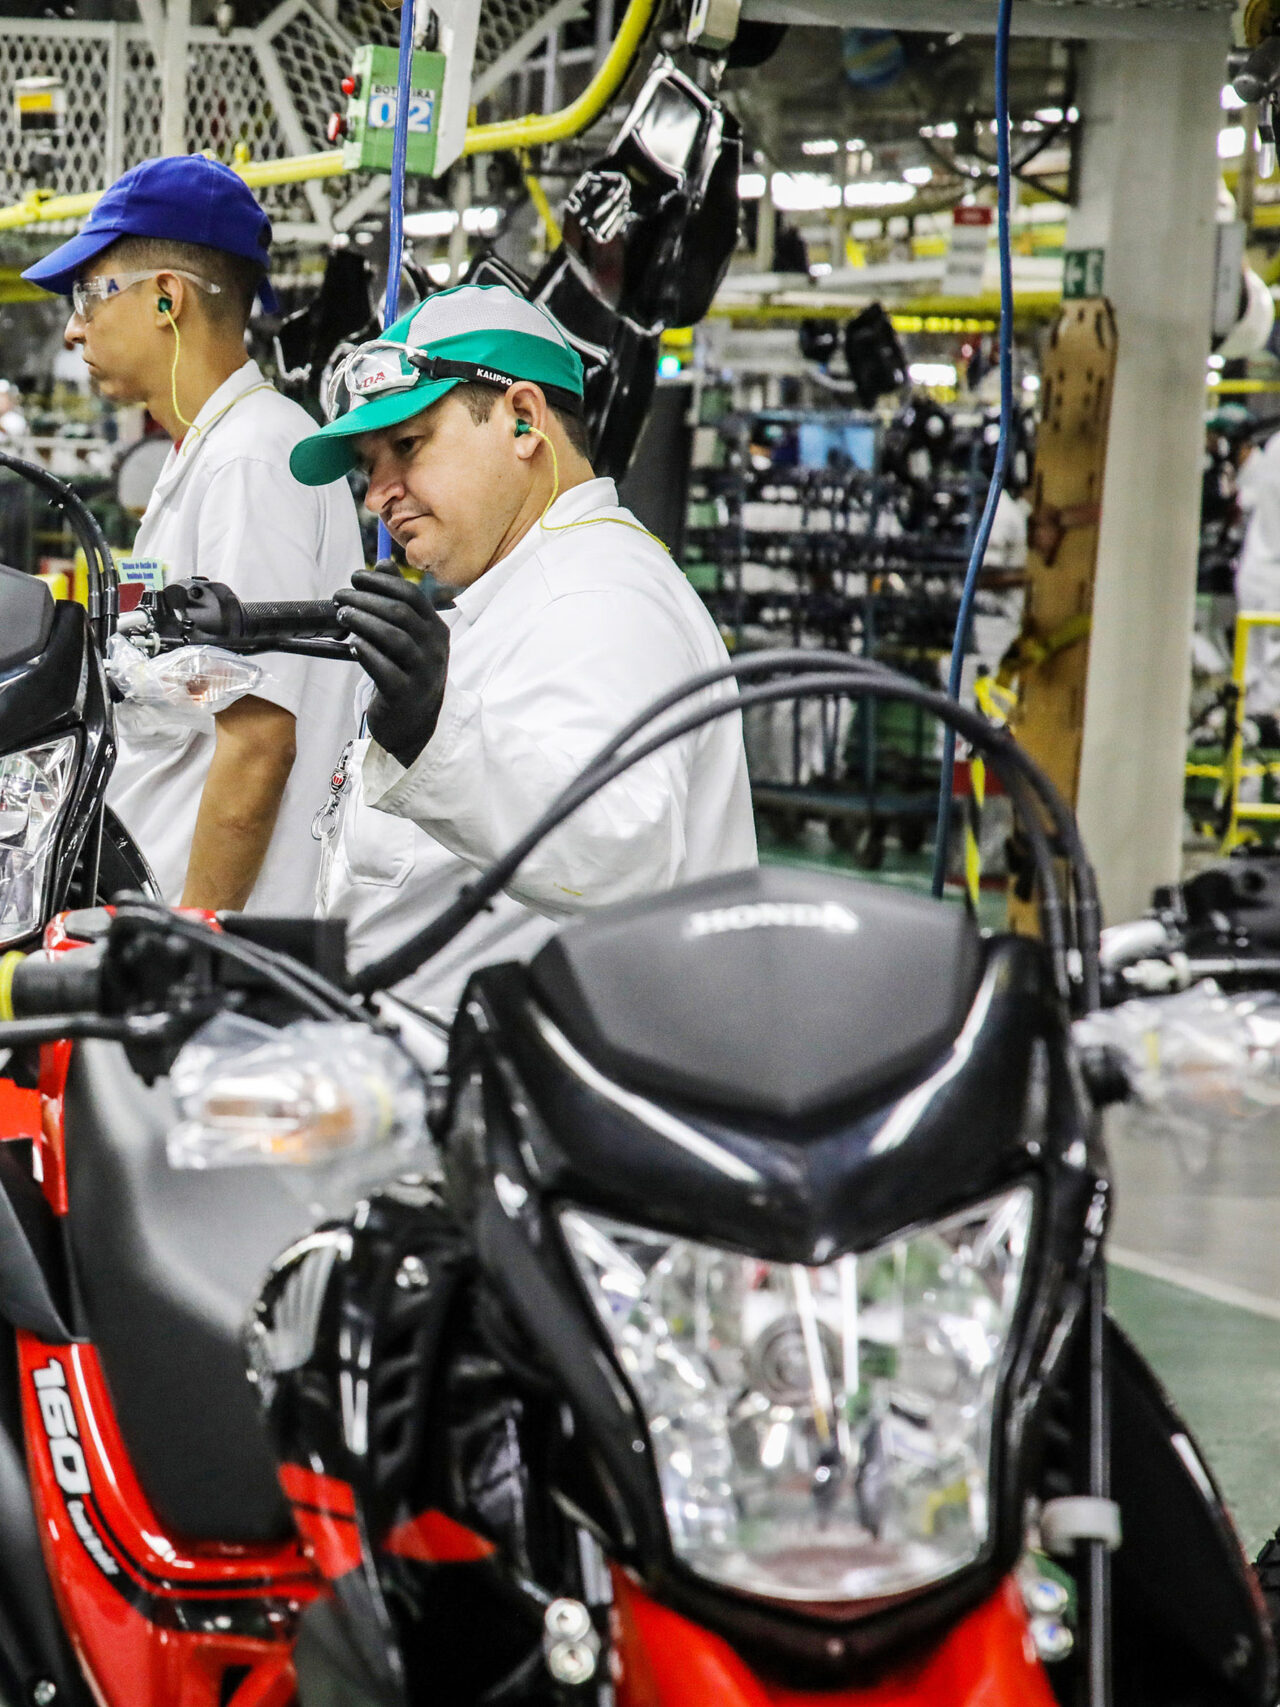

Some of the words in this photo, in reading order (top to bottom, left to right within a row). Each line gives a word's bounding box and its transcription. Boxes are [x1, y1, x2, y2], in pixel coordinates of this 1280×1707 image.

[375, 85, 431, 98] BOTIRA
[370, 96, 431, 133] 02
[476, 368, 513, 386] KALIPSO
[32, 1357, 92, 1494] 160
